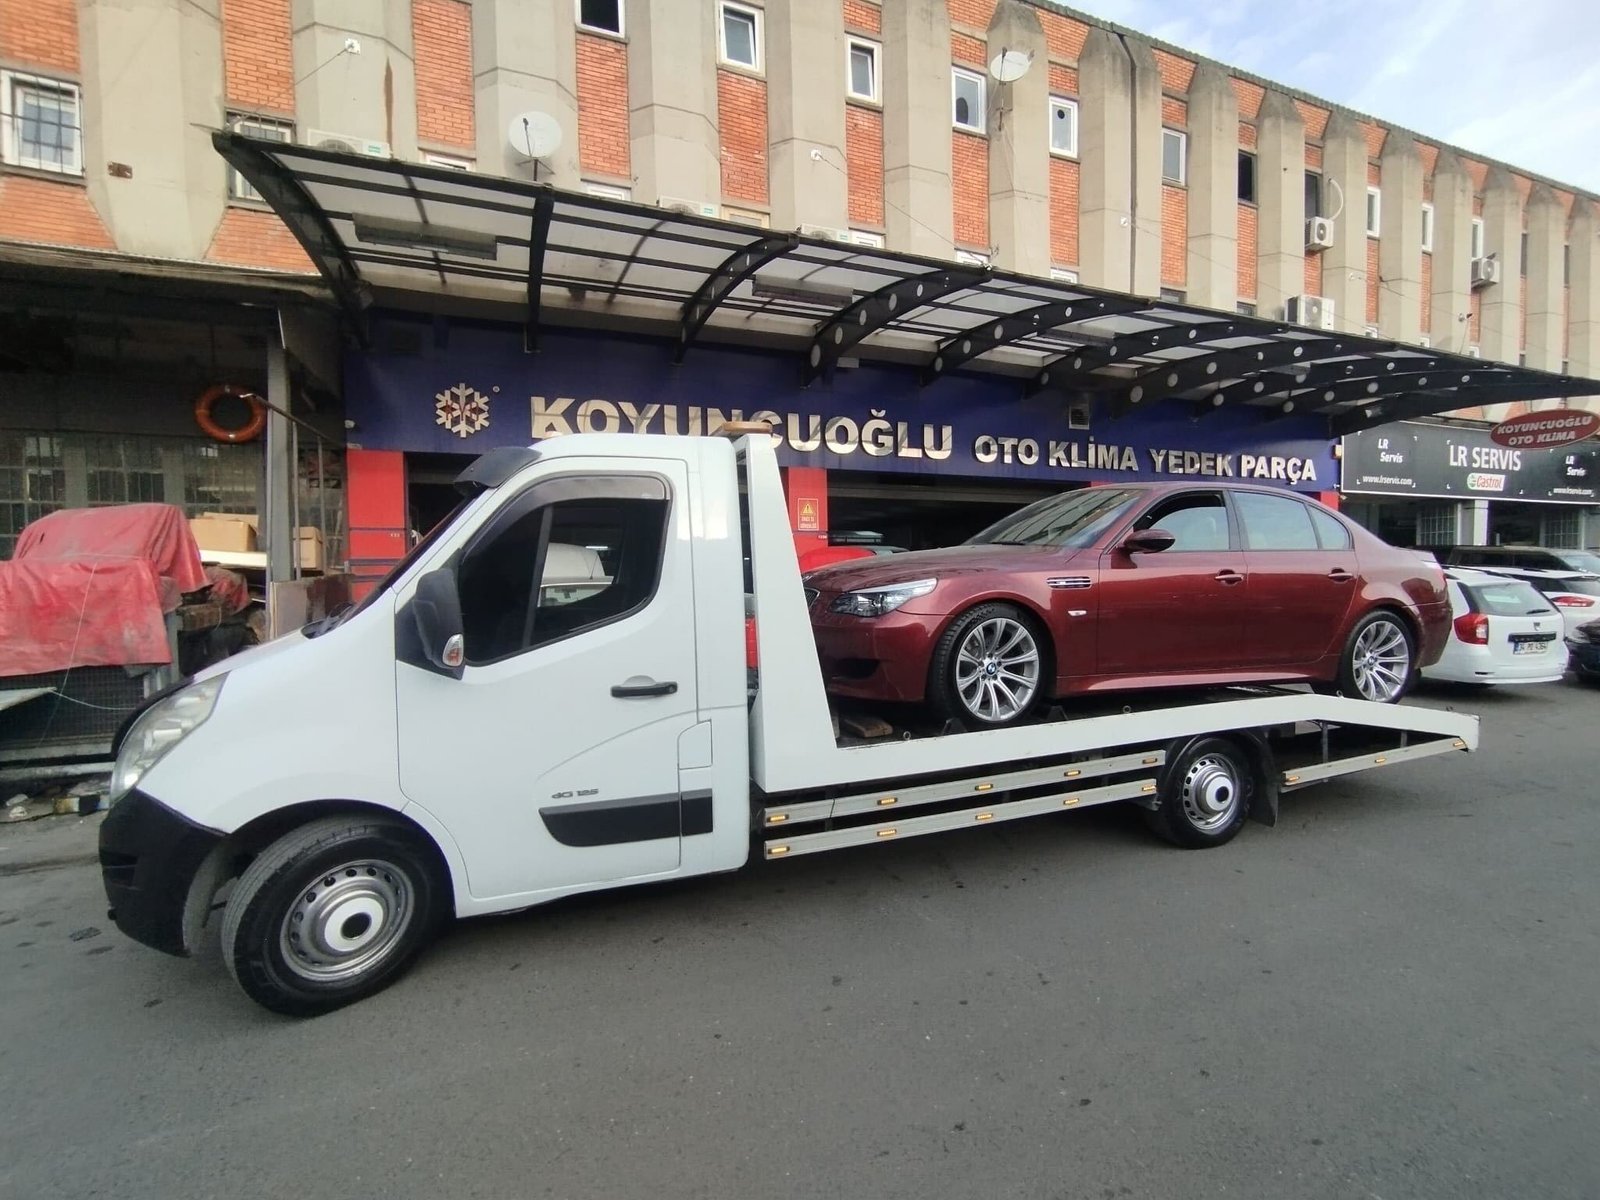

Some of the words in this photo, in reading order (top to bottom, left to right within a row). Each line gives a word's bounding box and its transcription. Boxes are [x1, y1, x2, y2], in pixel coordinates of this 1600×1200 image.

[1497, 416, 1592, 434] KOYUNCUOĞLU
[1377, 438, 1389, 449] LR
[1508, 436, 1533, 445] OTO
[974, 435, 1039, 465] OTO
[1048, 436, 1139, 471] KLİMA
[1150, 449, 1233, 477] YEDEK
[1240, 454, 1317, 485] PARÇA
[1380, 451, 1403, 463] Servis
[1449, 445, 1468, 467] LR
[1472, 447, 1521, 471] SERVIS
[1565, 455, 1574, 464] LR
[1566, 467, 1586, 476] Servis
[1362, 475, 1412, 485] www.lrservis.com
[1477, 476, 1503, 488] Castrol
[576, 788, 599, 797] 125
